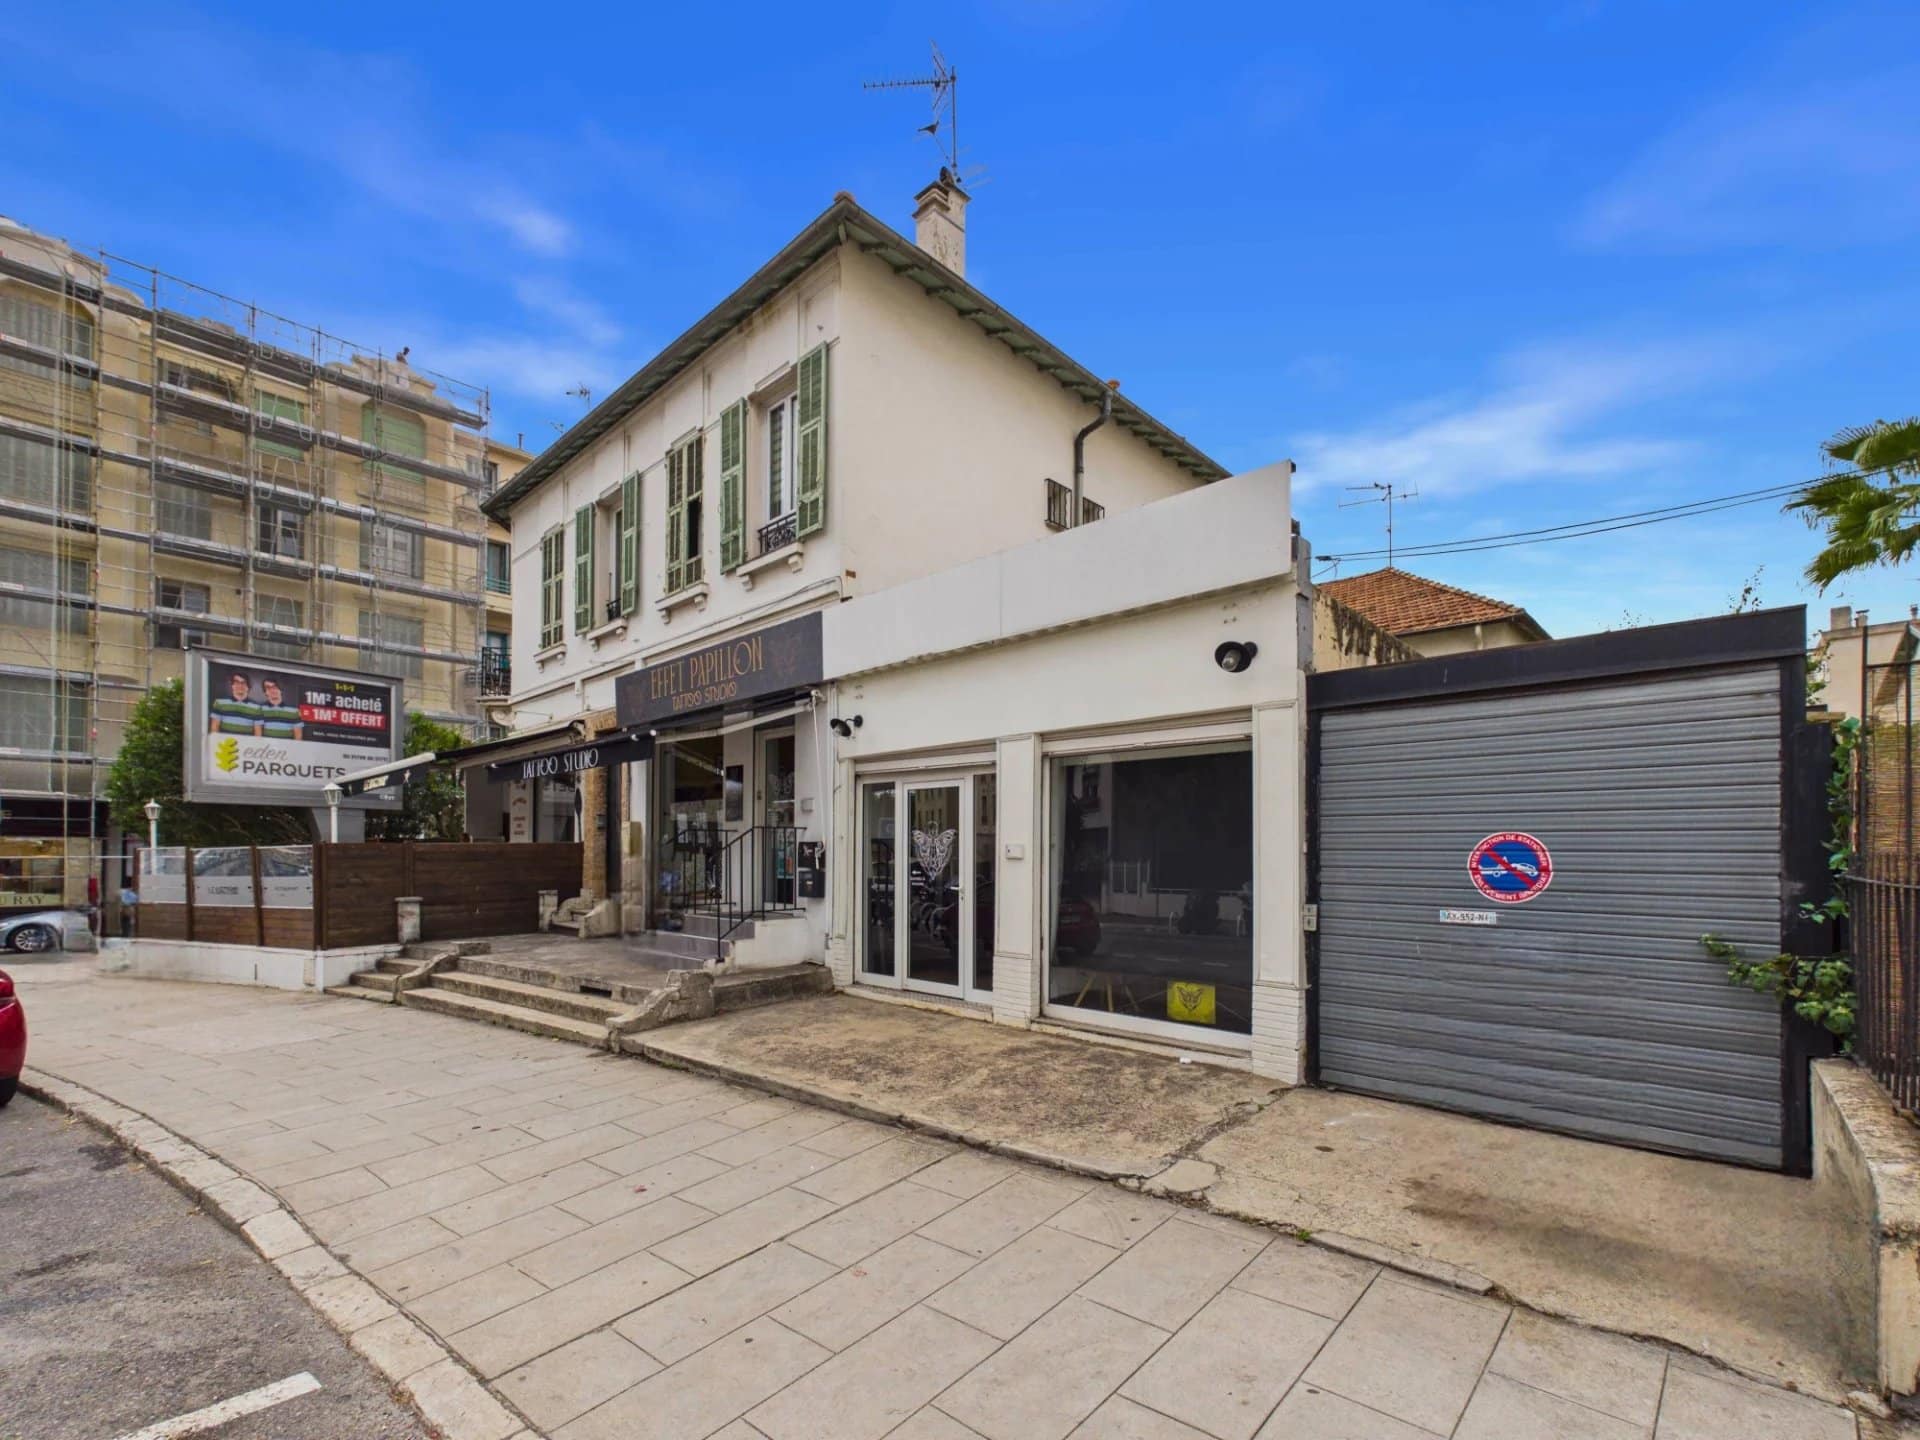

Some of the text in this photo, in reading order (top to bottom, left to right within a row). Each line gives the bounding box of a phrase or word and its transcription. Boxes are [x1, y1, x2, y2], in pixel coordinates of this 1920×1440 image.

[650, 636, 765, 700] EFFET PAPILLON
[335, 695, 382, 712] acheté
[341, 711, 384, 727] OFFERT
[243, 744, 288, 760] eden
[242, 760, 346, 779] PARQUETS
[523, 748, 599, 779] TATTOO STUDIO
[13, 895, 45, 905] RAY
